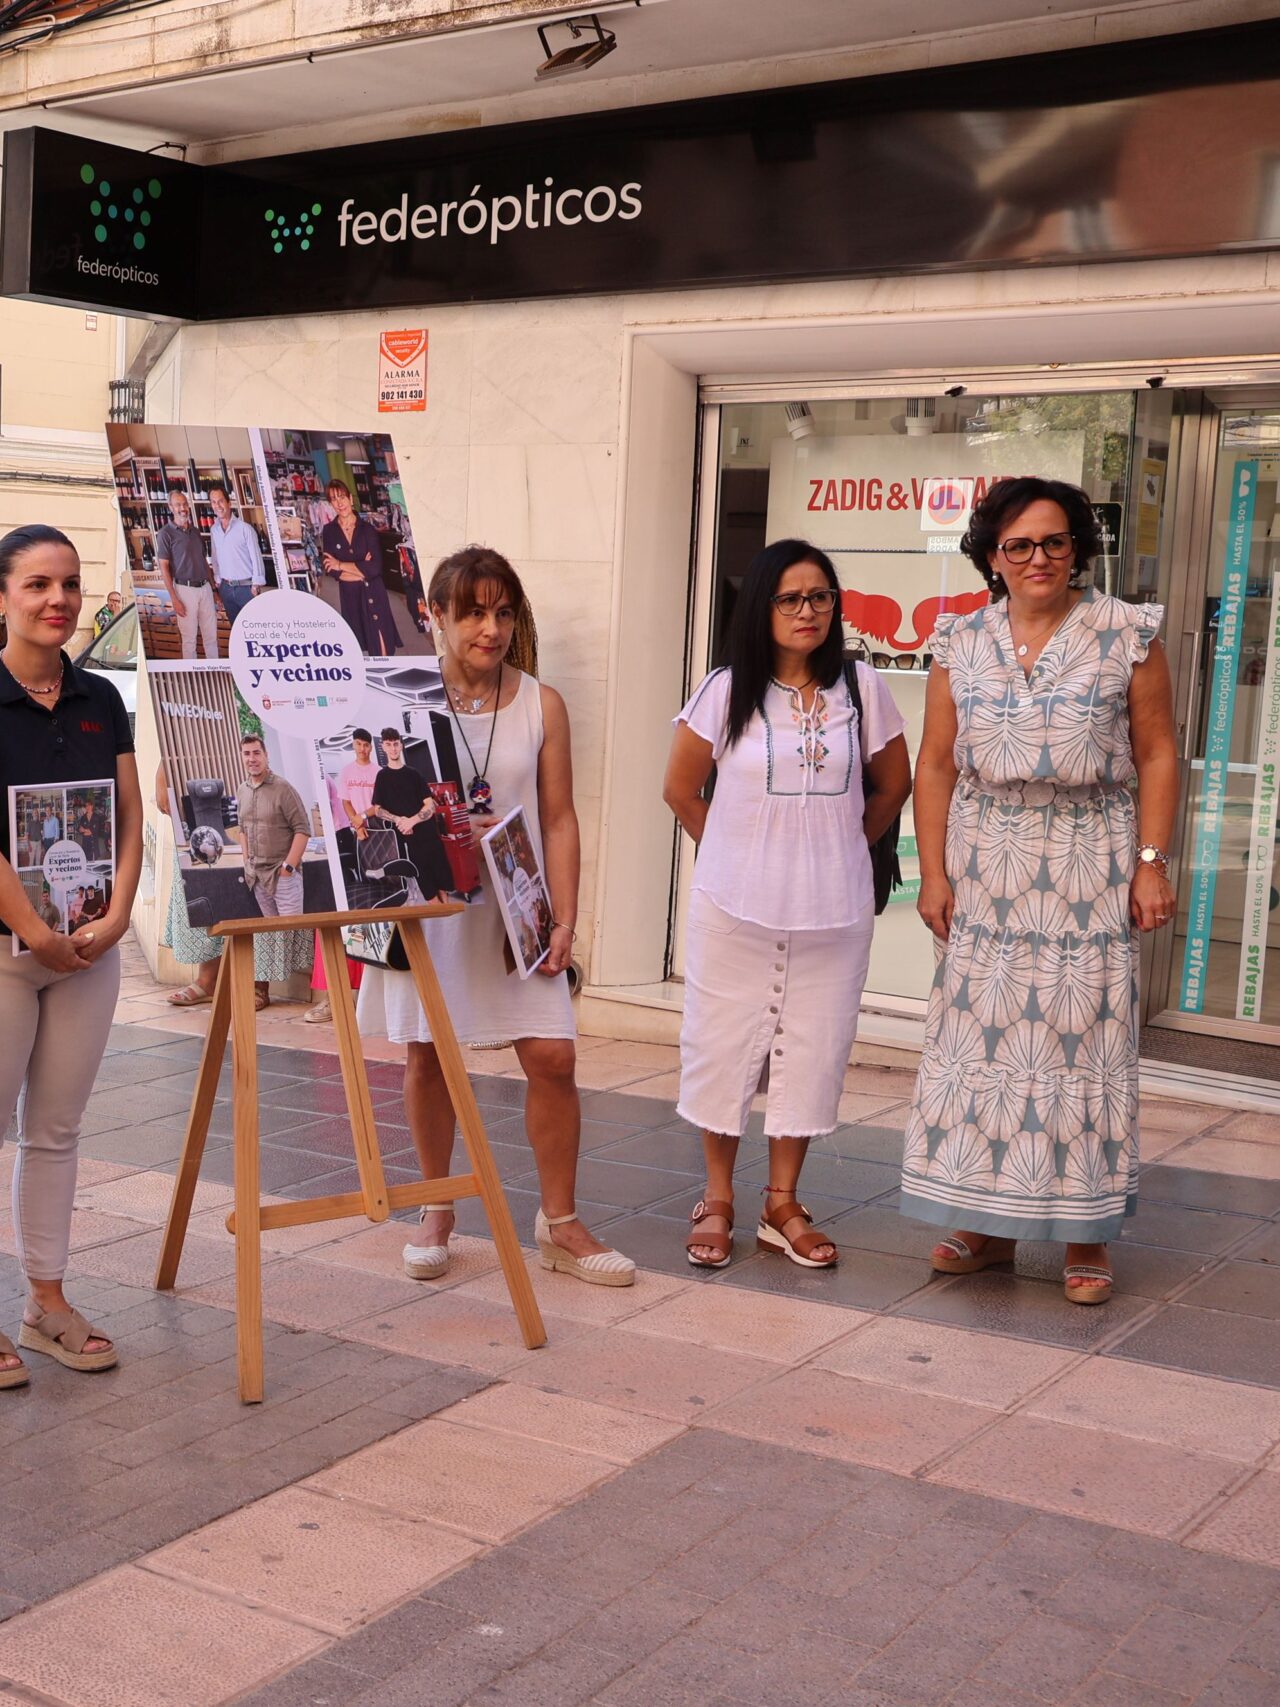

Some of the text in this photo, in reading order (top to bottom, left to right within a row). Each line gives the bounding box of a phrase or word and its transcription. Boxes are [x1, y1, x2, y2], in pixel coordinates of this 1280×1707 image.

[337, 176, 643, 247] federópticos
[77, 254, 159, 286] federópticos
[384, 369, 420, 379] ALARMA
[381, 389, 423, 400] 902 141 430
[1233, 501, 1247, 565] HASTA EL 50%
[242, 618, 336, 630] Comercio y Hostelería
[1223, 572, 1241, 648] REBAJAS
[243, 630, 306, 640] Local de Yecla
[244, 639, 344, 663] Expertos
[249, 662, 352, 688] y vecinos
[1214, 655, 1232, 731] federópticos
[1204, 760, 1223, 833] REBAJAS
[1257, 762, 1276, 838] REBAJAS
[49, 857, 81, 866] Expertos
[55, 864, 82, 872] vecinos
[1199, 890, 1208, 901] EL
[1254, 895, 1263, 906] EL
[1196, 903, 1206, 931] HASTA
[1252, 908, 1262, 937] HASTA
[1184, 937, 1204, 1010] REBAJAS
[1242, 944, 1261, 1018] REBAJAS
